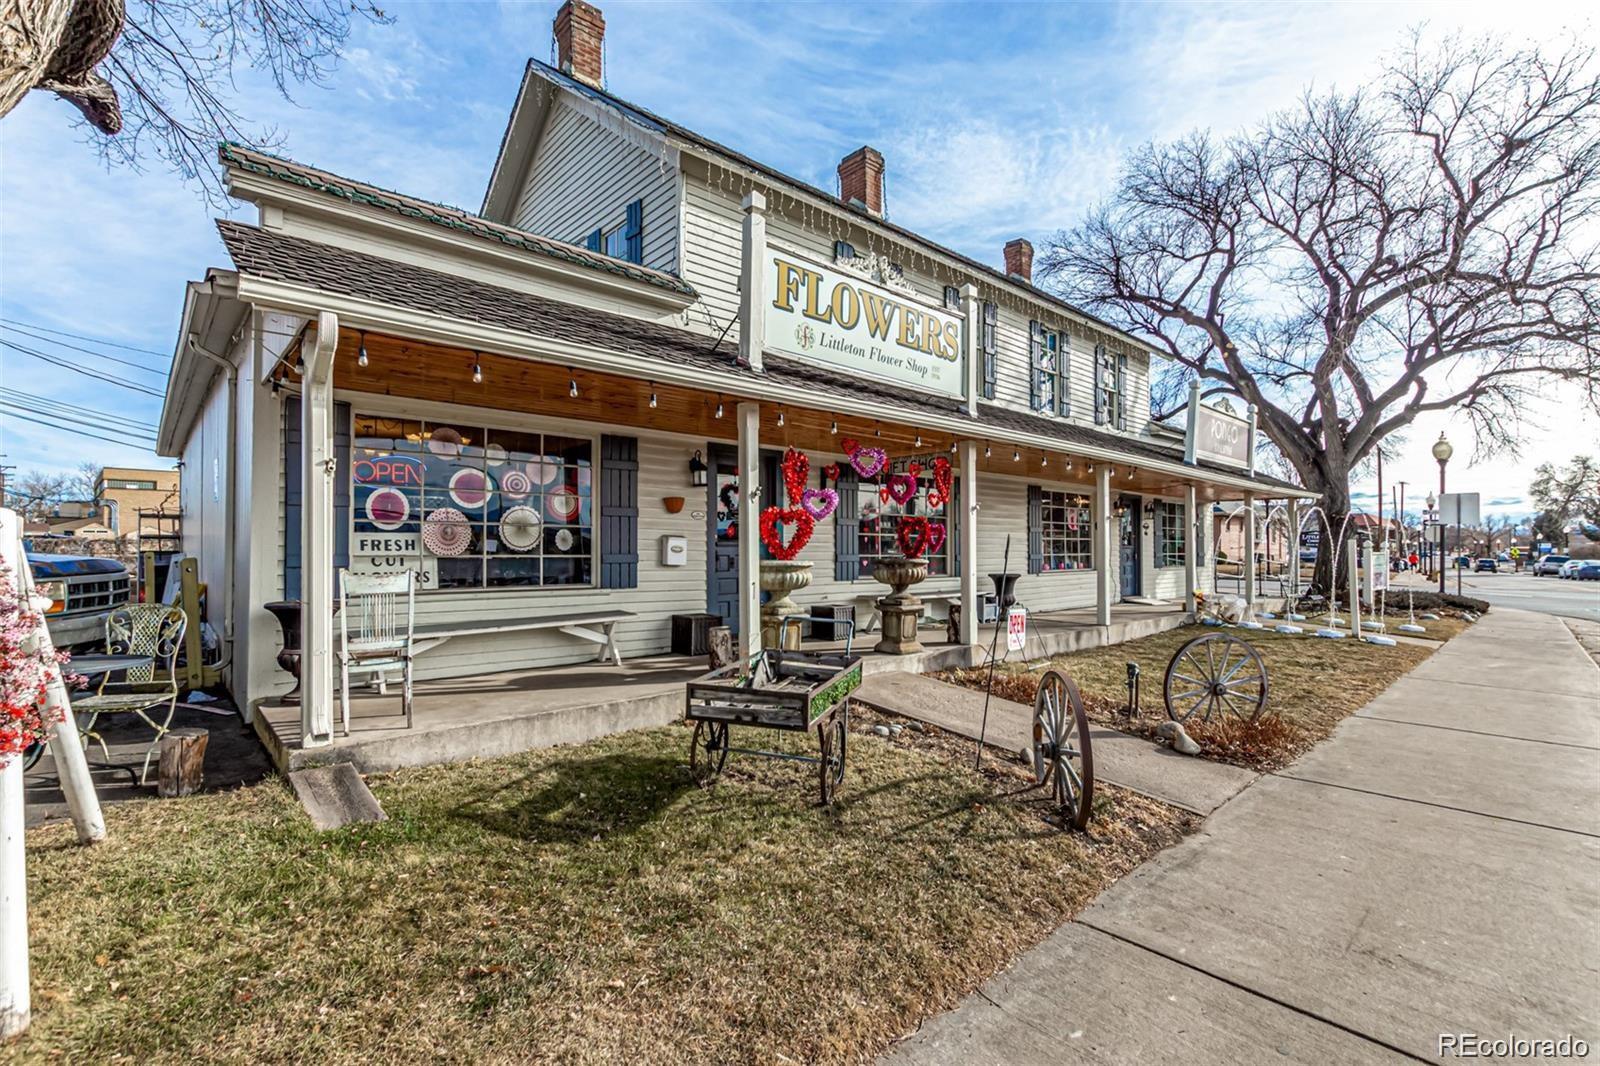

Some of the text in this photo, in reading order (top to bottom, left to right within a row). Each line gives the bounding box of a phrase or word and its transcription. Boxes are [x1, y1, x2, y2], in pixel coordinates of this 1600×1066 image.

[773, 258, 959, 362] FLOWERS
[819, 332, 865, 358] Littleton
[869, 346, 903, 368] Flower
[905, 357, 928, 378] Shop
[353, 460, 422, 484] OPEN
[360, 539, 416, 551] FRESH
